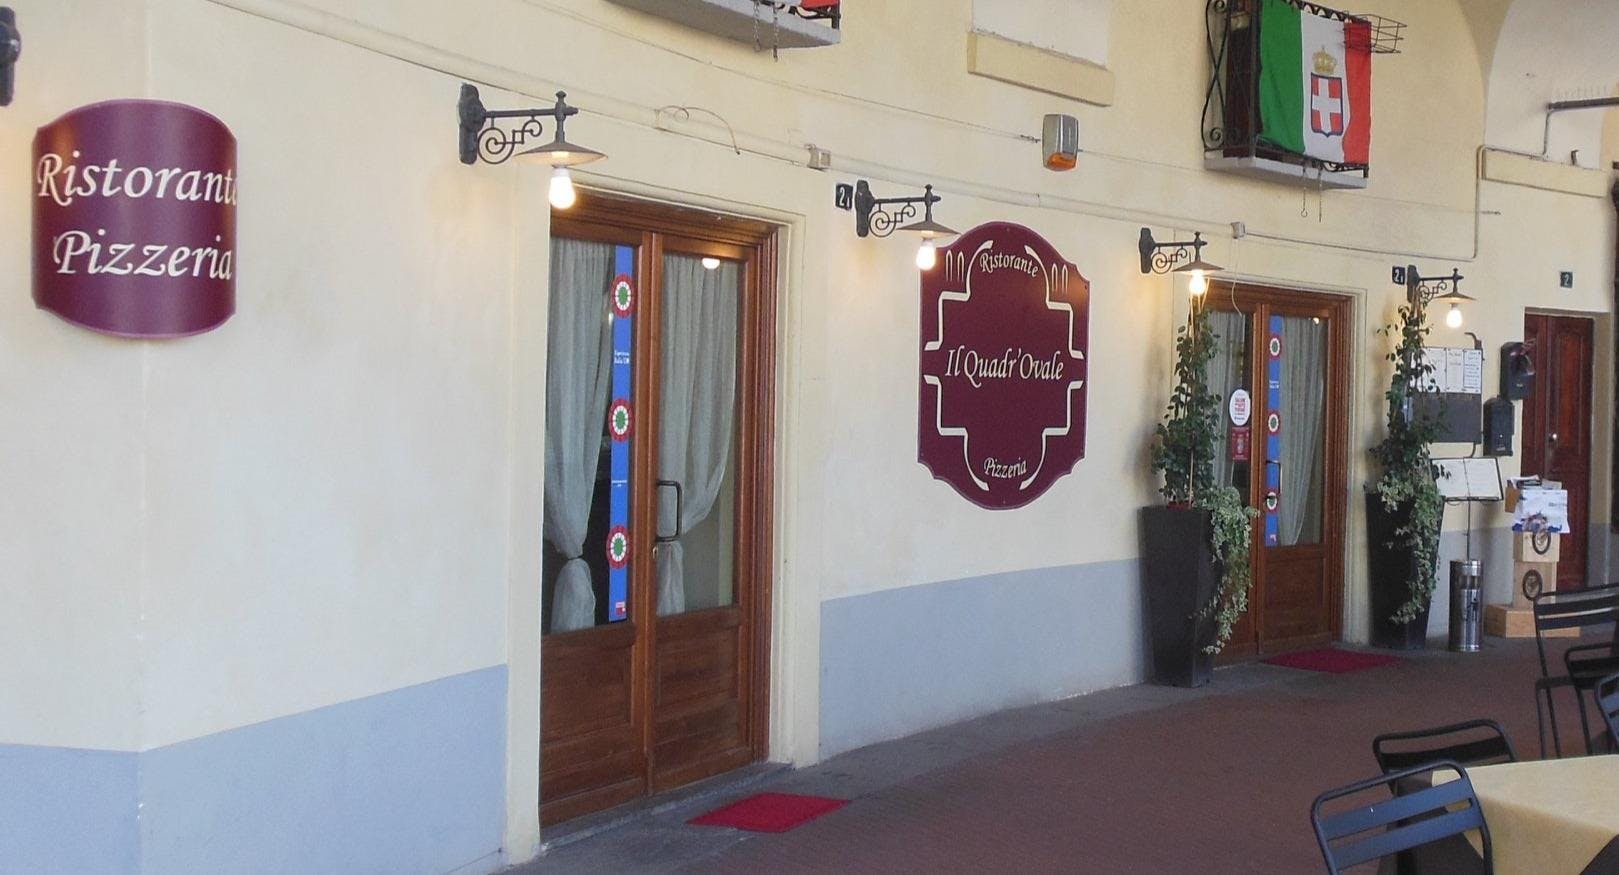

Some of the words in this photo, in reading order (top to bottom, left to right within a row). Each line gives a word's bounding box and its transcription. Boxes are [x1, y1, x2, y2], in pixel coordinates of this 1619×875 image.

[53, 228, 233, 280] Pizzeria
[979, 252, 1039, 279] Ristorante
[945, 345, 964, 377] Il
[964, 347, 1064, 388] Quadr'Ovale
[983, 456, 1028, 479] Pizzeria
